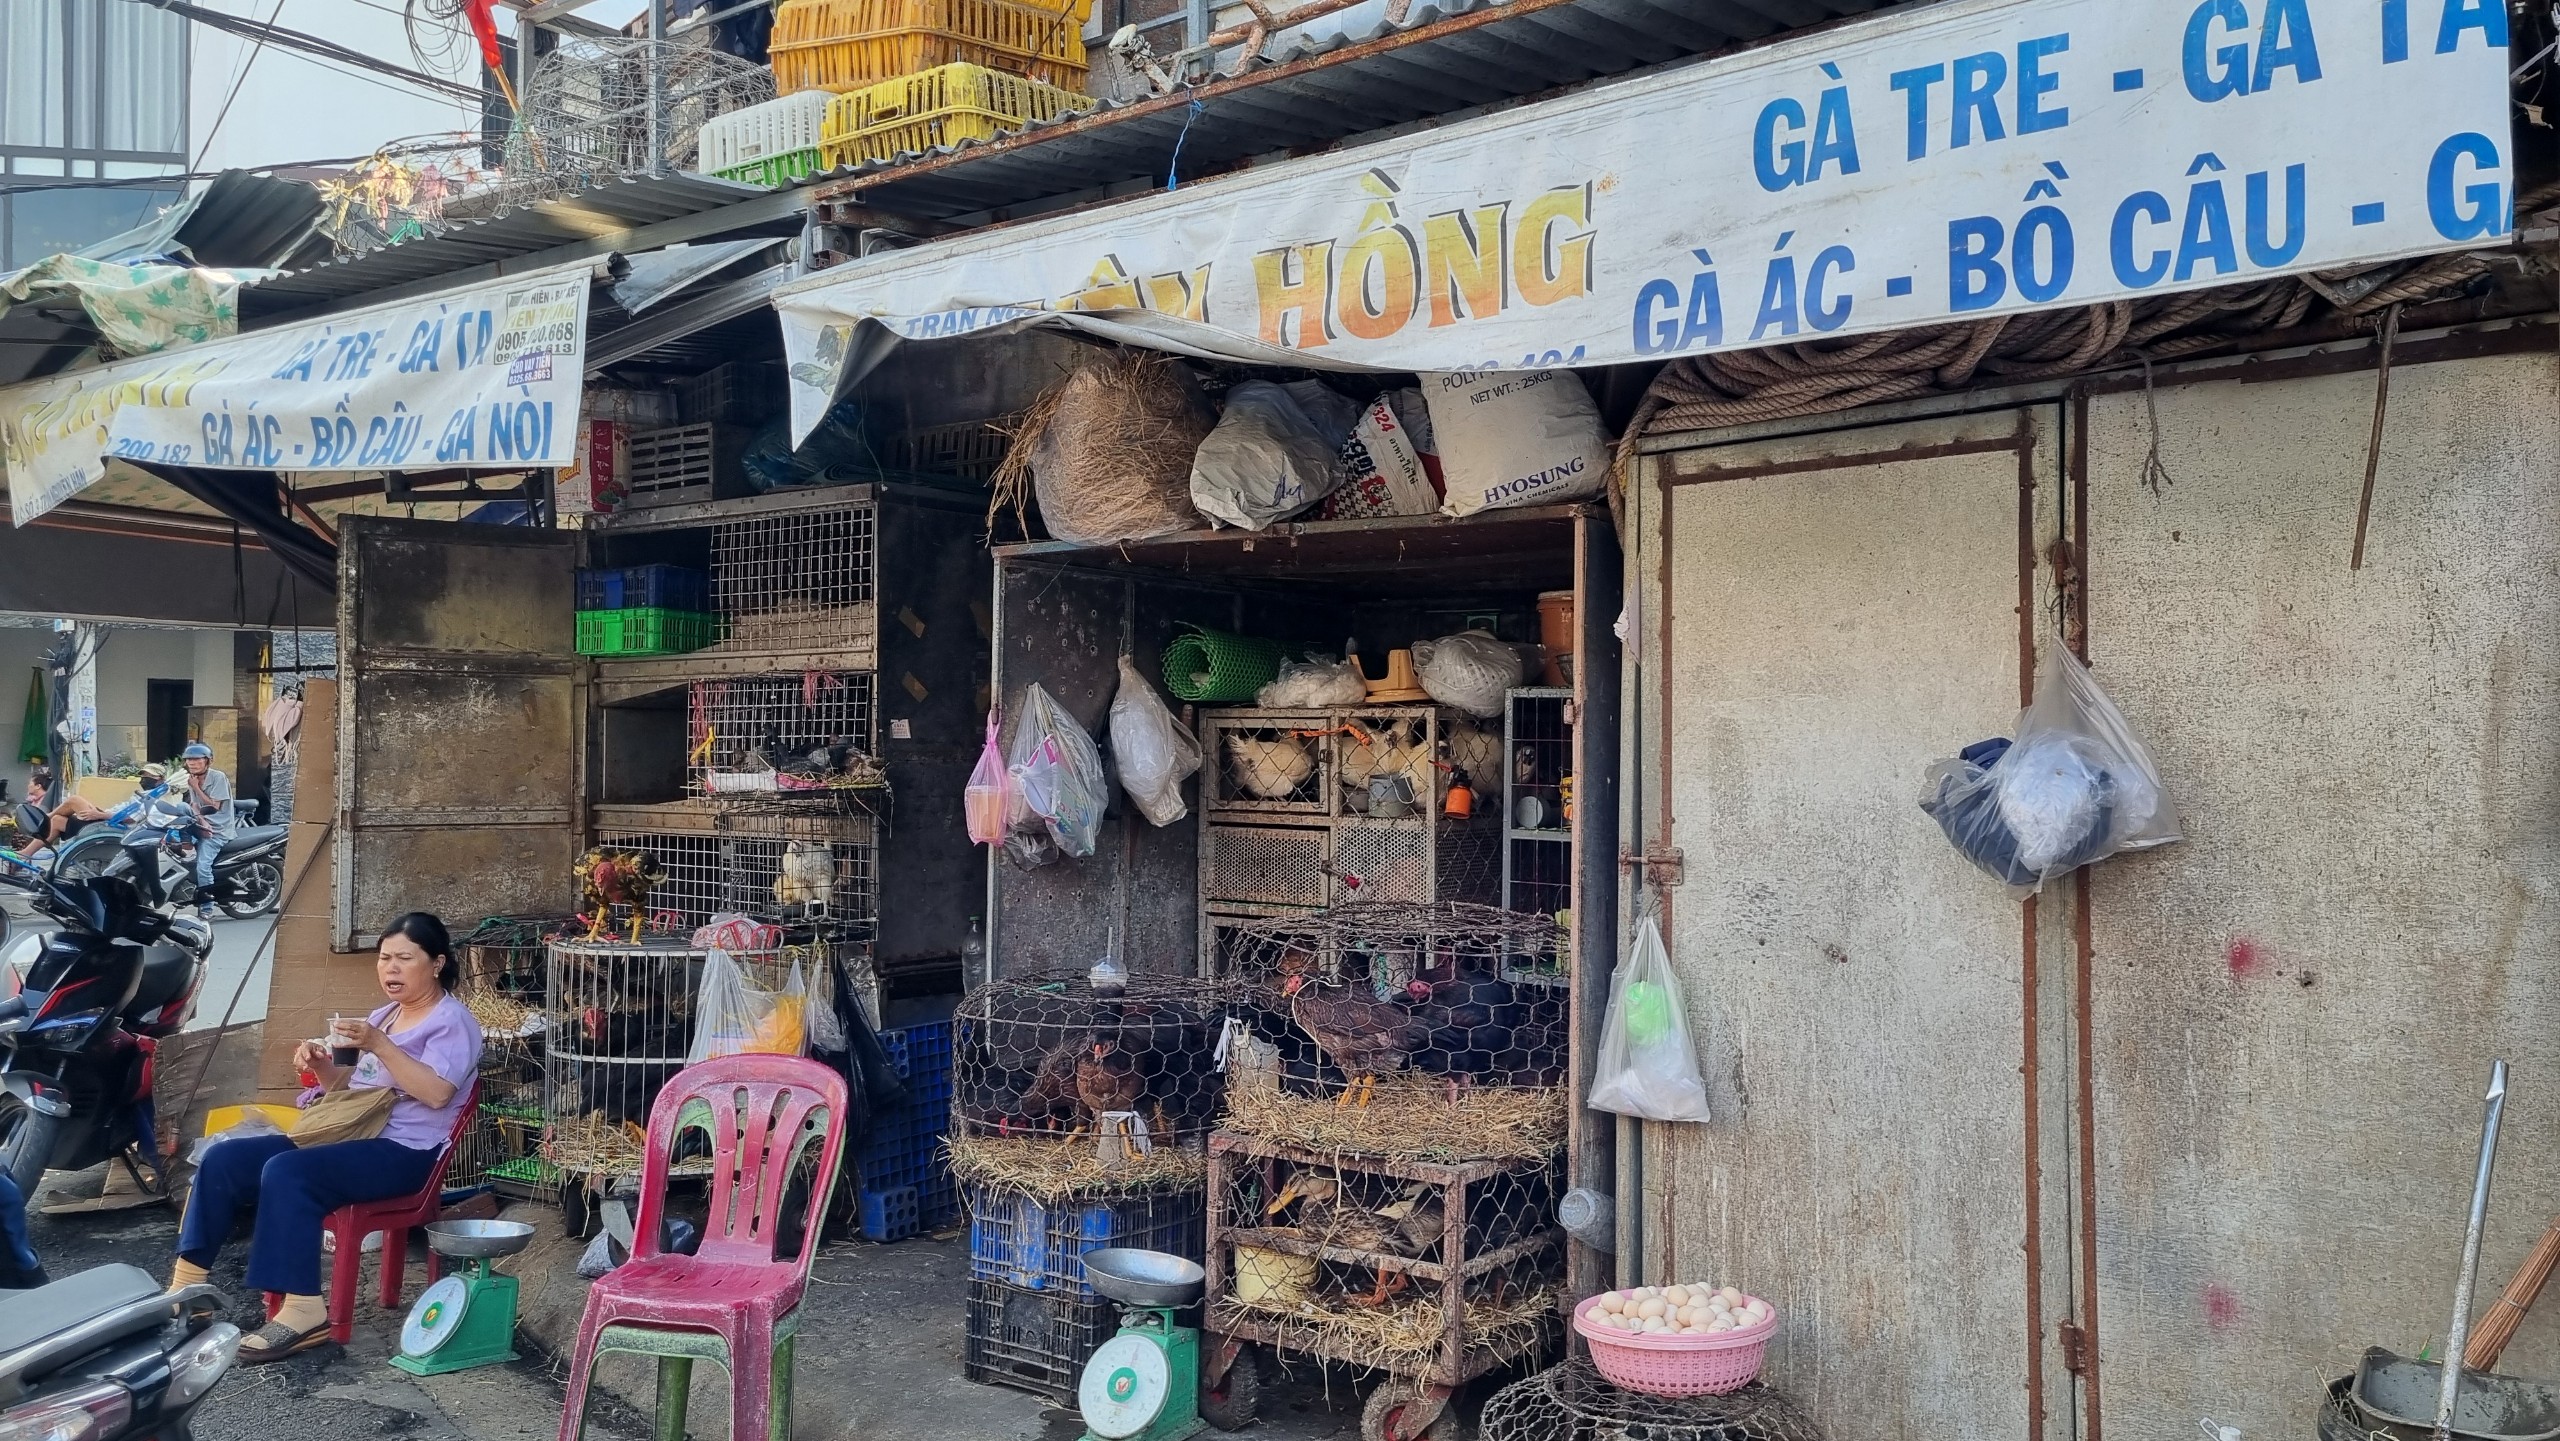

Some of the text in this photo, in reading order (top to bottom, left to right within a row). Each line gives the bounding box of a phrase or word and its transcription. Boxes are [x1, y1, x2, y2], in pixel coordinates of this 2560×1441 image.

[1754, 62, 1860, 192] GÀ
[1890, 33, 2070, 162] TRE
[1251, 167, 1598, 350] HỒNG
[1632, 248, 1724, 358] GÀ
[1753, 230, 1854, 339] ÁC
[1949, 160, 2073, 313] BỒ
[2109, 151, 2307, 284] CÂU
[2426, 131, 2514, 241] G
[323, 328, 387, 382] TRE
[398, 304, 447, 374] GÀ
[1372, 406, 1396, 432] 324
[1470, 389, 1491, 406] NET
[1521, 371, 1553, 389] 25KGS
[112, 438, 192, 465] 200 182
[202, 399, 233, 466] GÀ
[242, 400, 283, 467] ÁC
[358, 400, 424, 467] CÂU
[488, 385, 553, 461] NÒI
[1484, 456, 1585, 503] HYOSUNG
[1505, 482, 1569, 506] VINA CHEMICALS
